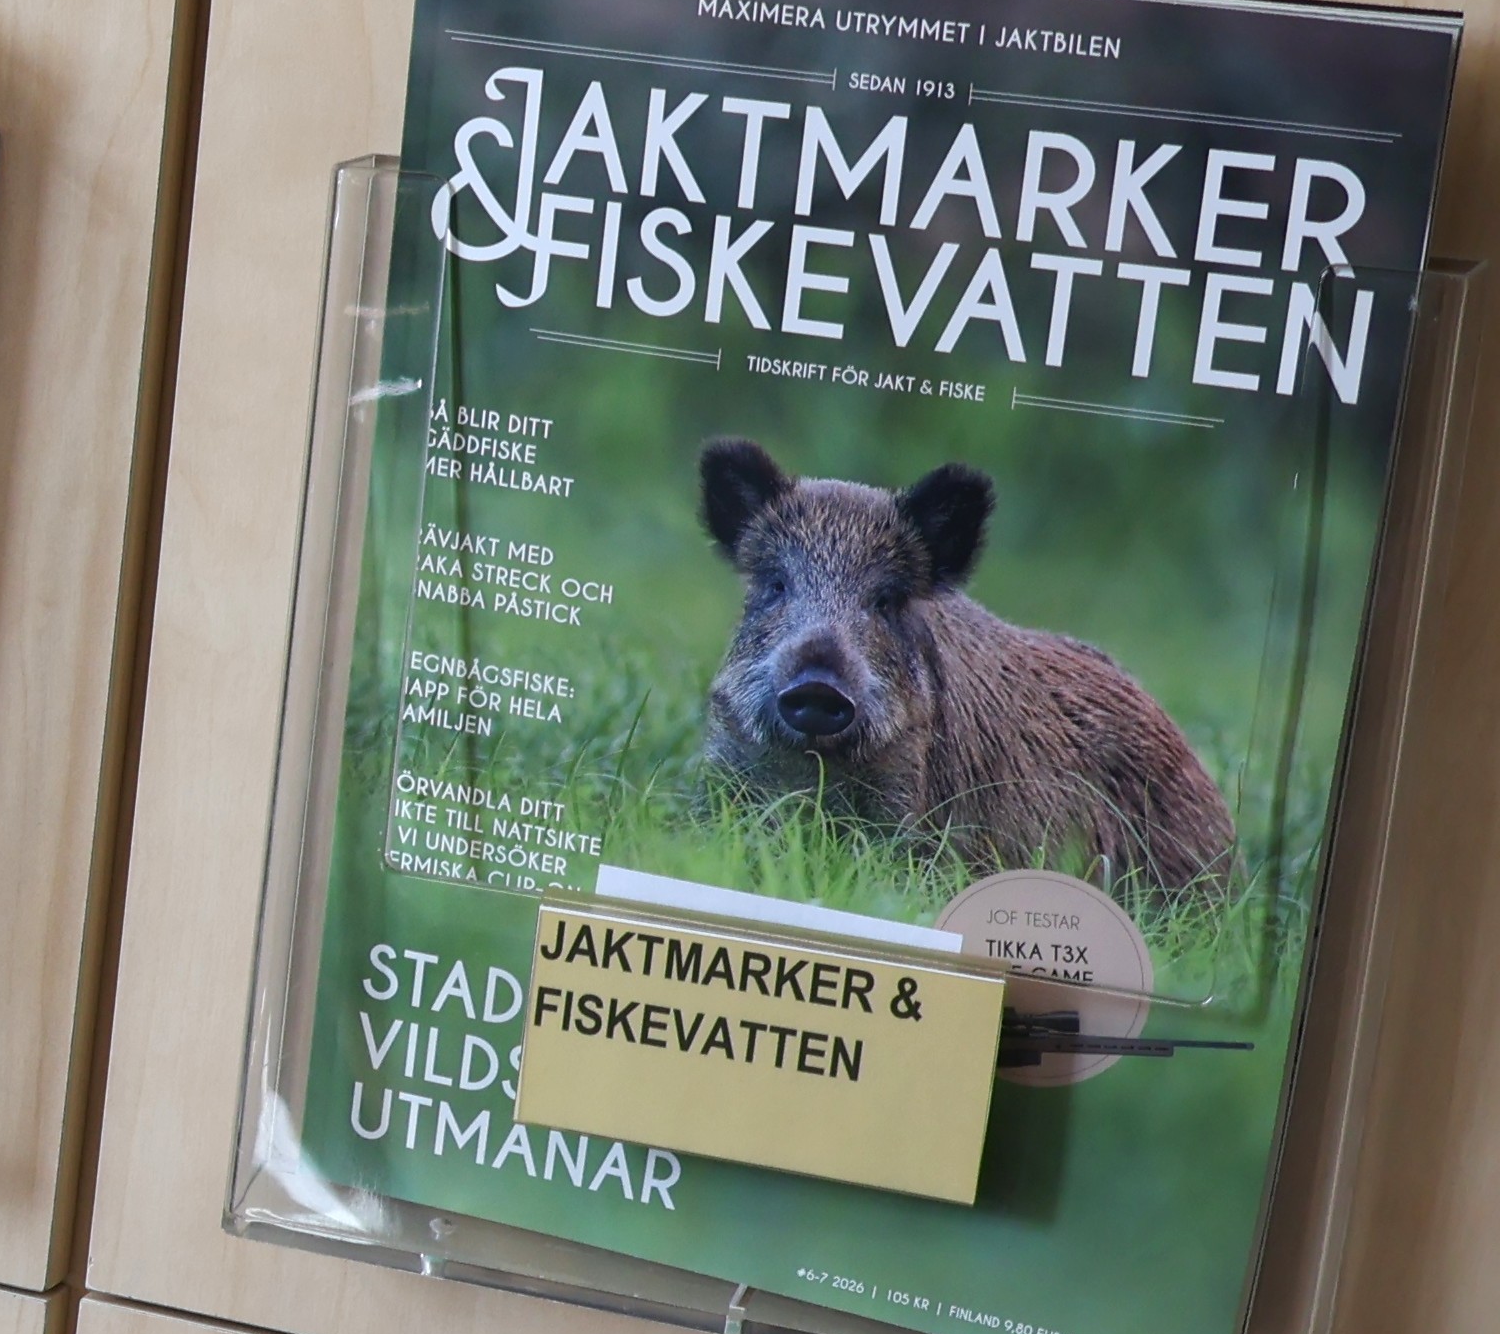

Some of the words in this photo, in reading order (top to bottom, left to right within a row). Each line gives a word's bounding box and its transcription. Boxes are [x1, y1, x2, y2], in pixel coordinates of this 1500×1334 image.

[835, 11, 972, 47] UTRYMMET
[978, 25, 986, 47] I
[994, 25, 1122, 61] JAKTBILEN
[849, 72, 907, 97] SEDAN
[914, 77, 956, 100] 1913
[485, 65, 1370, 276] JAKTMARKER
[496, 187, 1374, 407] FISKEVATTEN
[746, 353, 828, 382] TIDSKRIFT
[832, 358, 869, 387] FÖR
[874, 368, 916, 393] JAKT
[921, 375, 933, 395] &
[938, 377, 986, 402] FISKE
[987, 909, 1019, 927] JOF
[1026, 911, 1080, 931] TESTAR
[541, 919, 874, 1014] JAKTMARKER
[890, 975, 923, 1023] &
[986, 938, 1046, 962] TIKKA
[1052, 943, 1089, 965] T3X
[533, 986, 863, 1083] FISKEVATTEN
